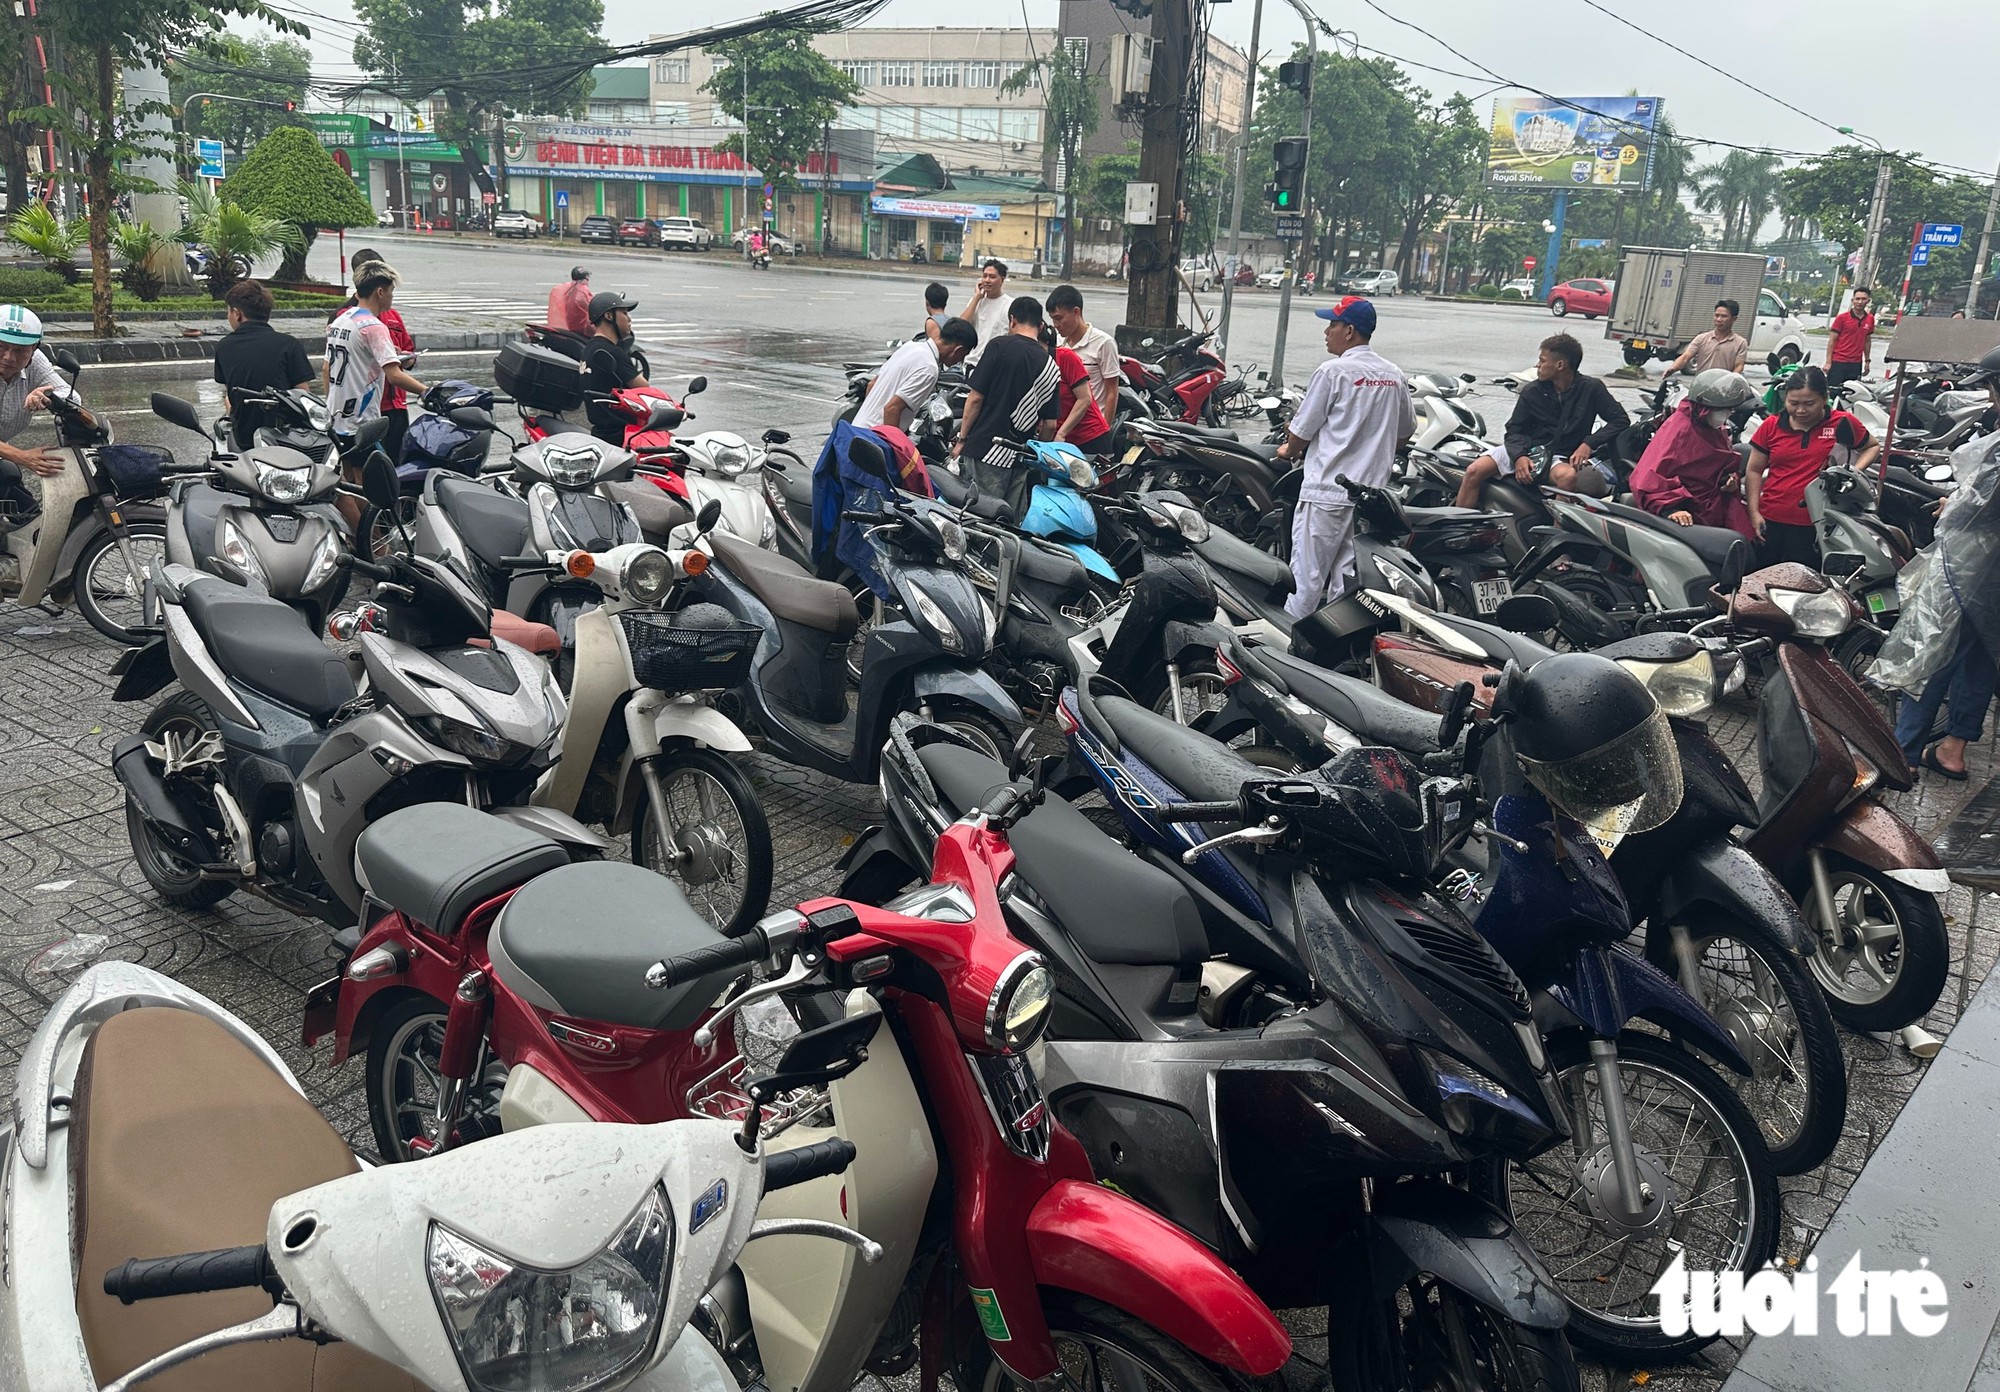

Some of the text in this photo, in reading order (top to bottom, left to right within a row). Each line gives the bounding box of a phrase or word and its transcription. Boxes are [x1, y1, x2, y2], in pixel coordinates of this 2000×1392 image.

[614, 129, 632, 137] AN
[537, 136, 579, 167] BỆNH
[583, 138, 618, 169] VIỆN
[622, 144, 645, 167] ĐA
[649, 145, 693, 169] KHOA
[1492, 173, 1543, 183] Royal Shine
[1924, 231, 1957, 243] TRẦN PHÚ
[1366, 379, 1397, 387] HONDA
[1478, 581, 1507, 597] 37-AD
[1354, 590, 1386, 618] YAMAHA
[874, 634, 897, 652] HONDA
[1402, 667, 1454, 692] LEA
[573, 1035, 607, 1050] Cub
